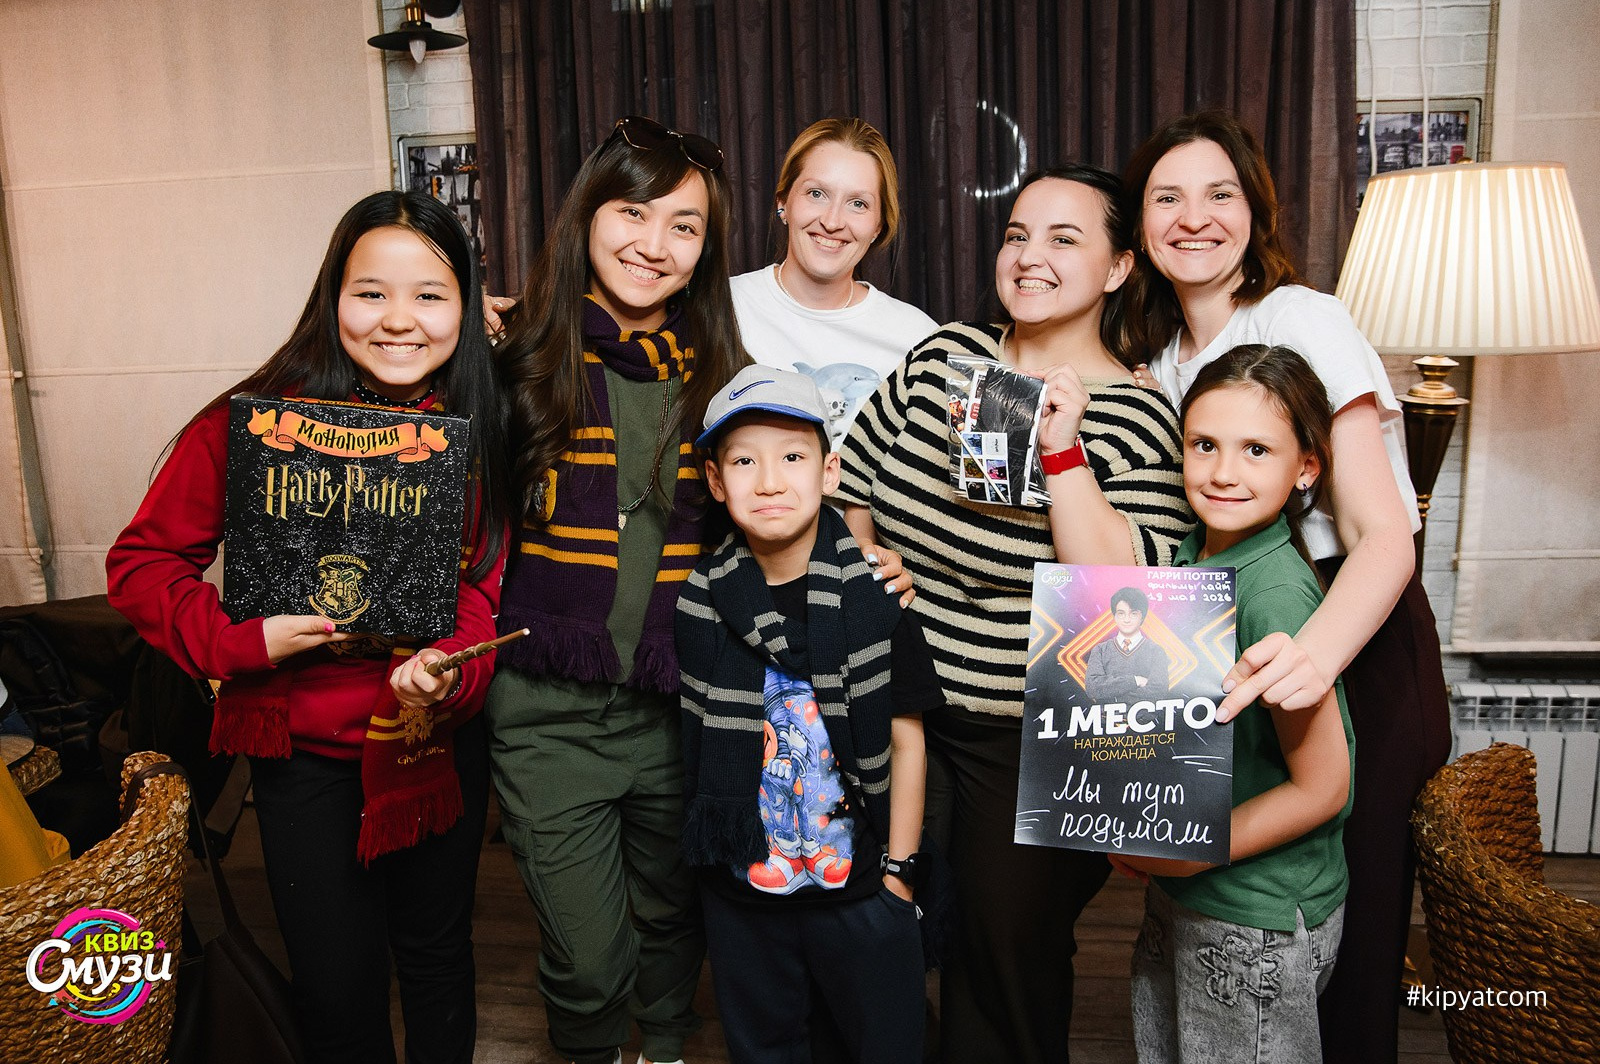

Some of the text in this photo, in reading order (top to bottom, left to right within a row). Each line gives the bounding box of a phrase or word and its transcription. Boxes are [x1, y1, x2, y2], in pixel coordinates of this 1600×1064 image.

[297, 419, 401, 455] Монополия
[258, 464, 429, 534] Harry Potter
[1041, 571, 1073, 585] Смузи
[1147, 571, 1229, 581] ГАРРИ ПОТТЕР
[1037, 696, 1217, 740] 1 МЕСТО
[1074, 732, 1176, 750] НАГРАЖДАЕТСЯ
[1091, 747, 1157, 762] КОМАНДА
[1053, 765, 1185, 822] Мы тут
[1060, 812, 1213, 849] подумали
